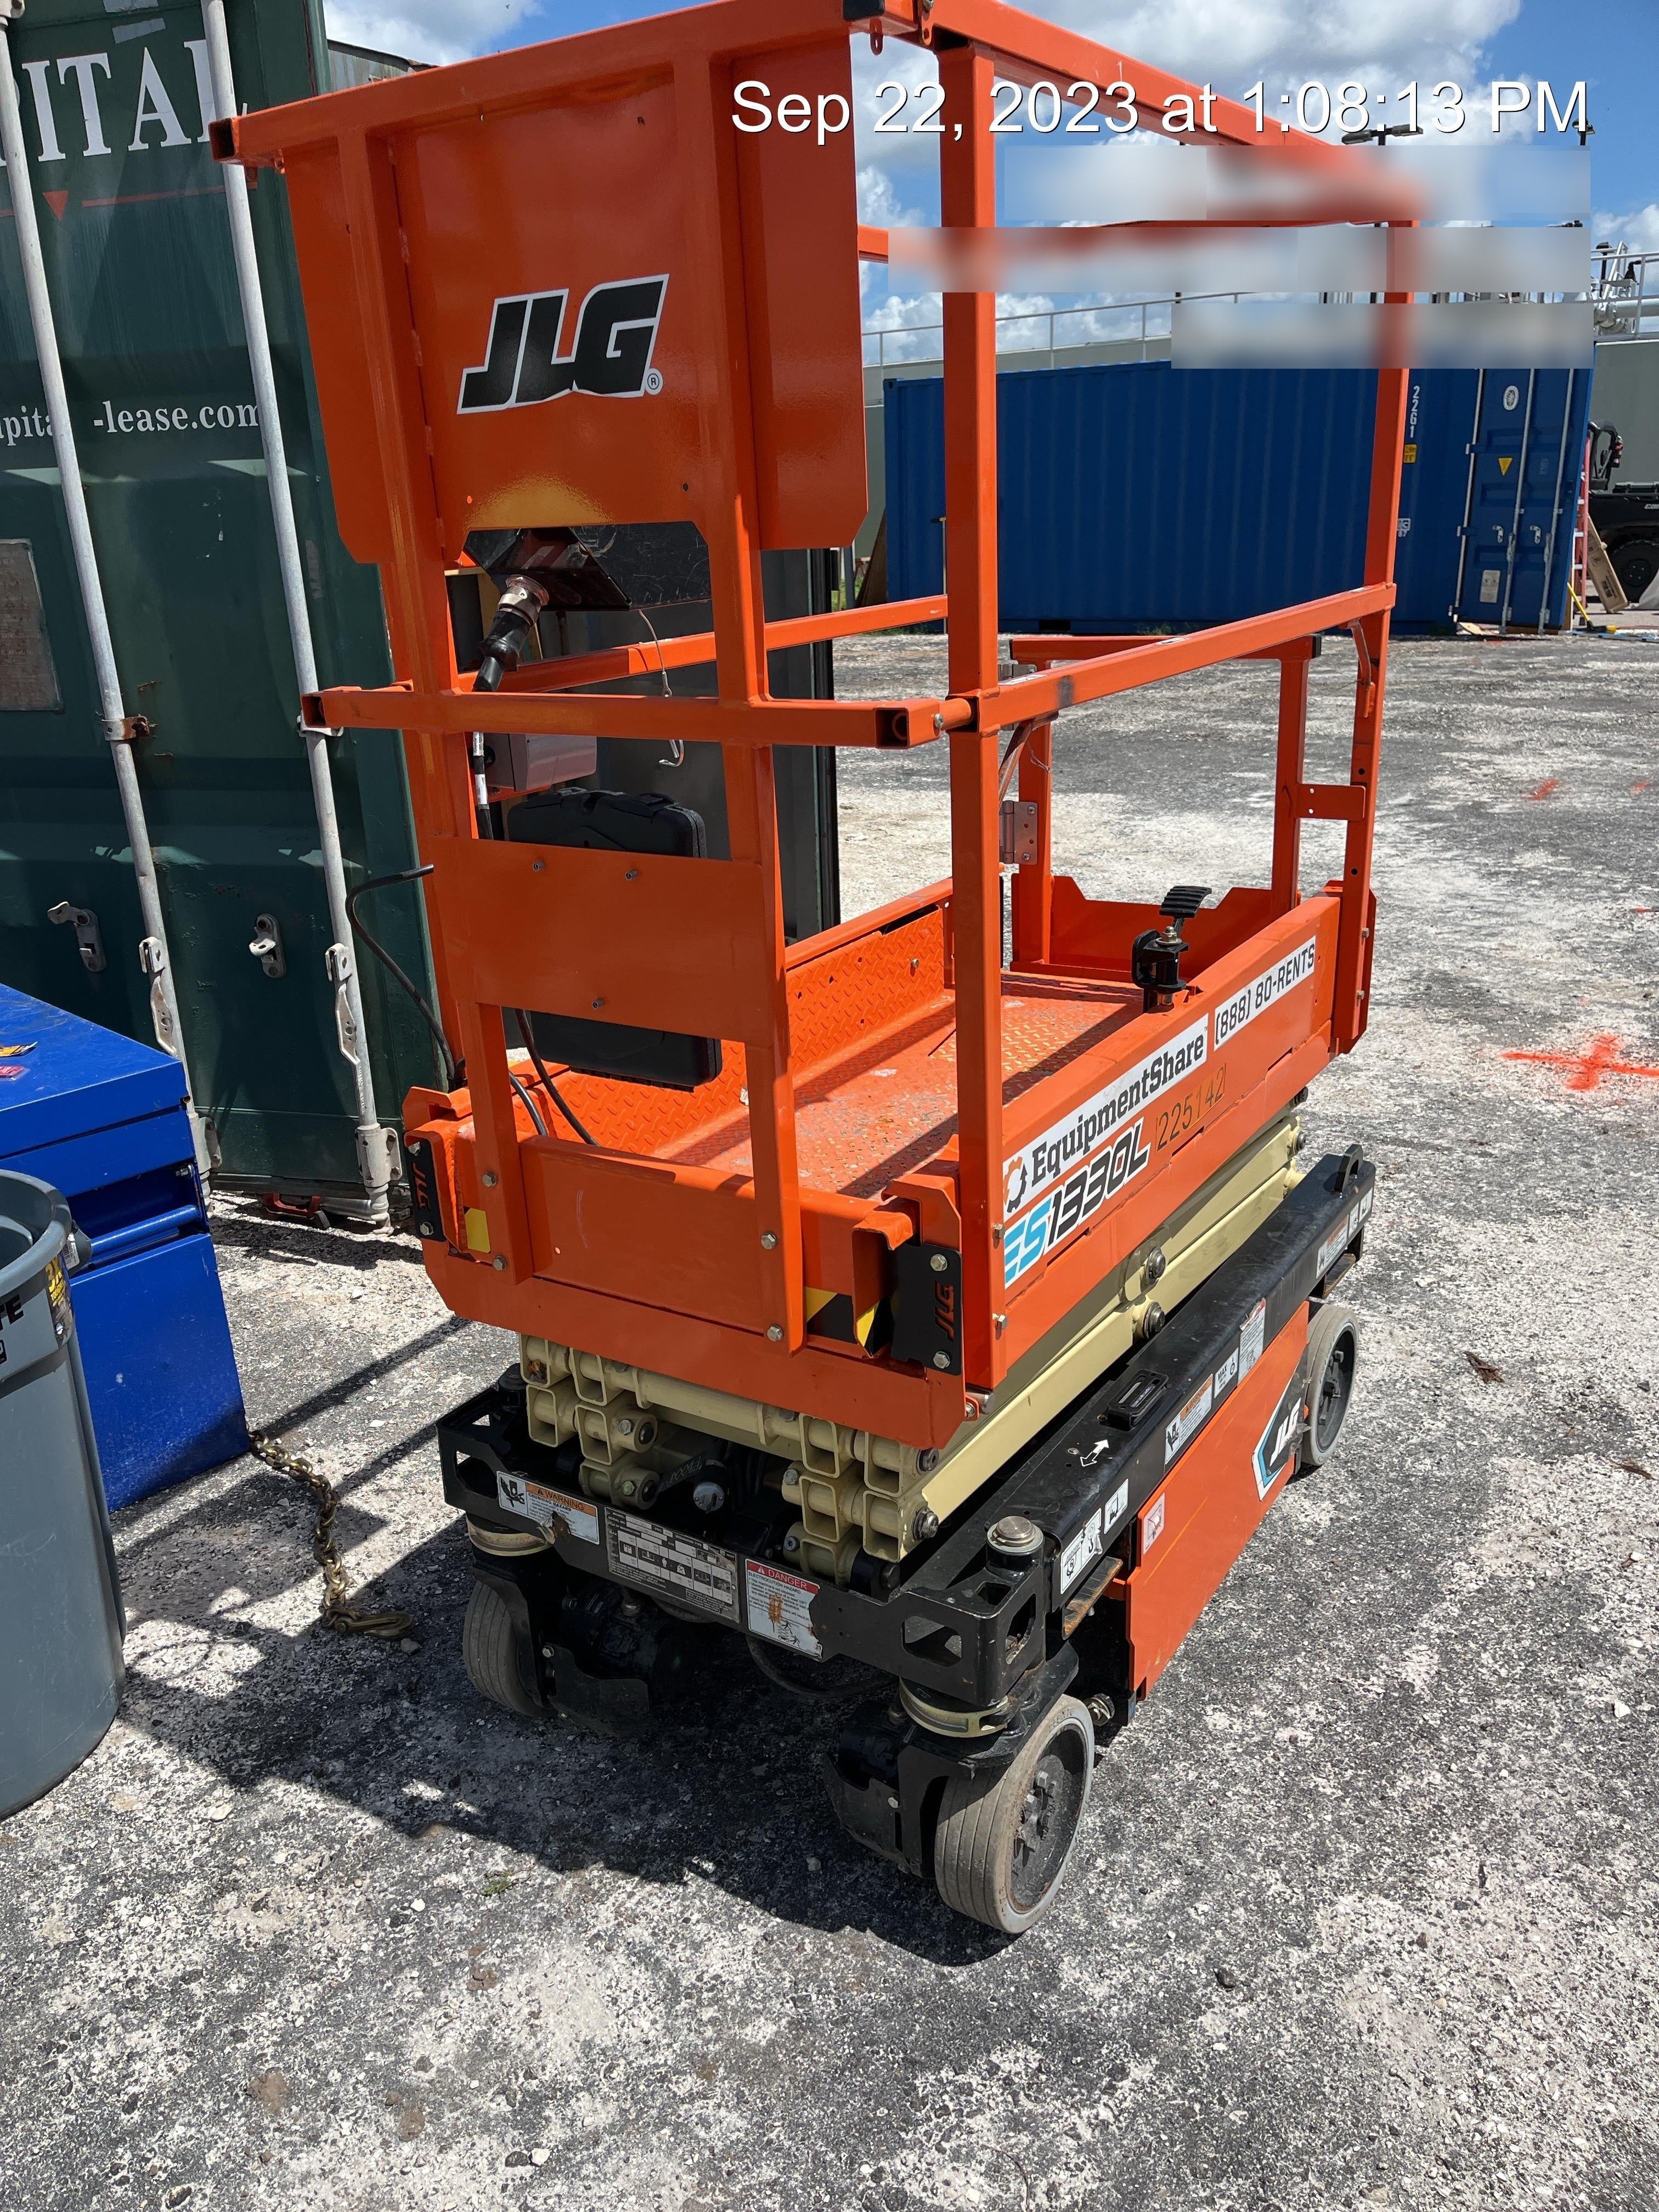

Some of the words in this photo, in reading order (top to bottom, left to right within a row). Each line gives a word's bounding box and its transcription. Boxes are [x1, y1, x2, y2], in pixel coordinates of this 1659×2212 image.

[458, 273, 670, 415] JLG
[1031, 1034, 1204, 1187] EquipmentShare
[1216, 989, 1251, 1045] (888)
[1255, 944, 1315, 1009] 80-RENTS
[1157, 1066, 1224, 1152] 225142
[934, 1280, 955, 1342] JLG
[1269, 1397, 1302, 1468] JLG
[545, 1491, 584, 1511] WARNING
[749, 1572, 783, 1588] ELECTROCUTION
[784, 1584, 801, 1594] HAZARD
[769, 1569, 808, 1590] DANGER
